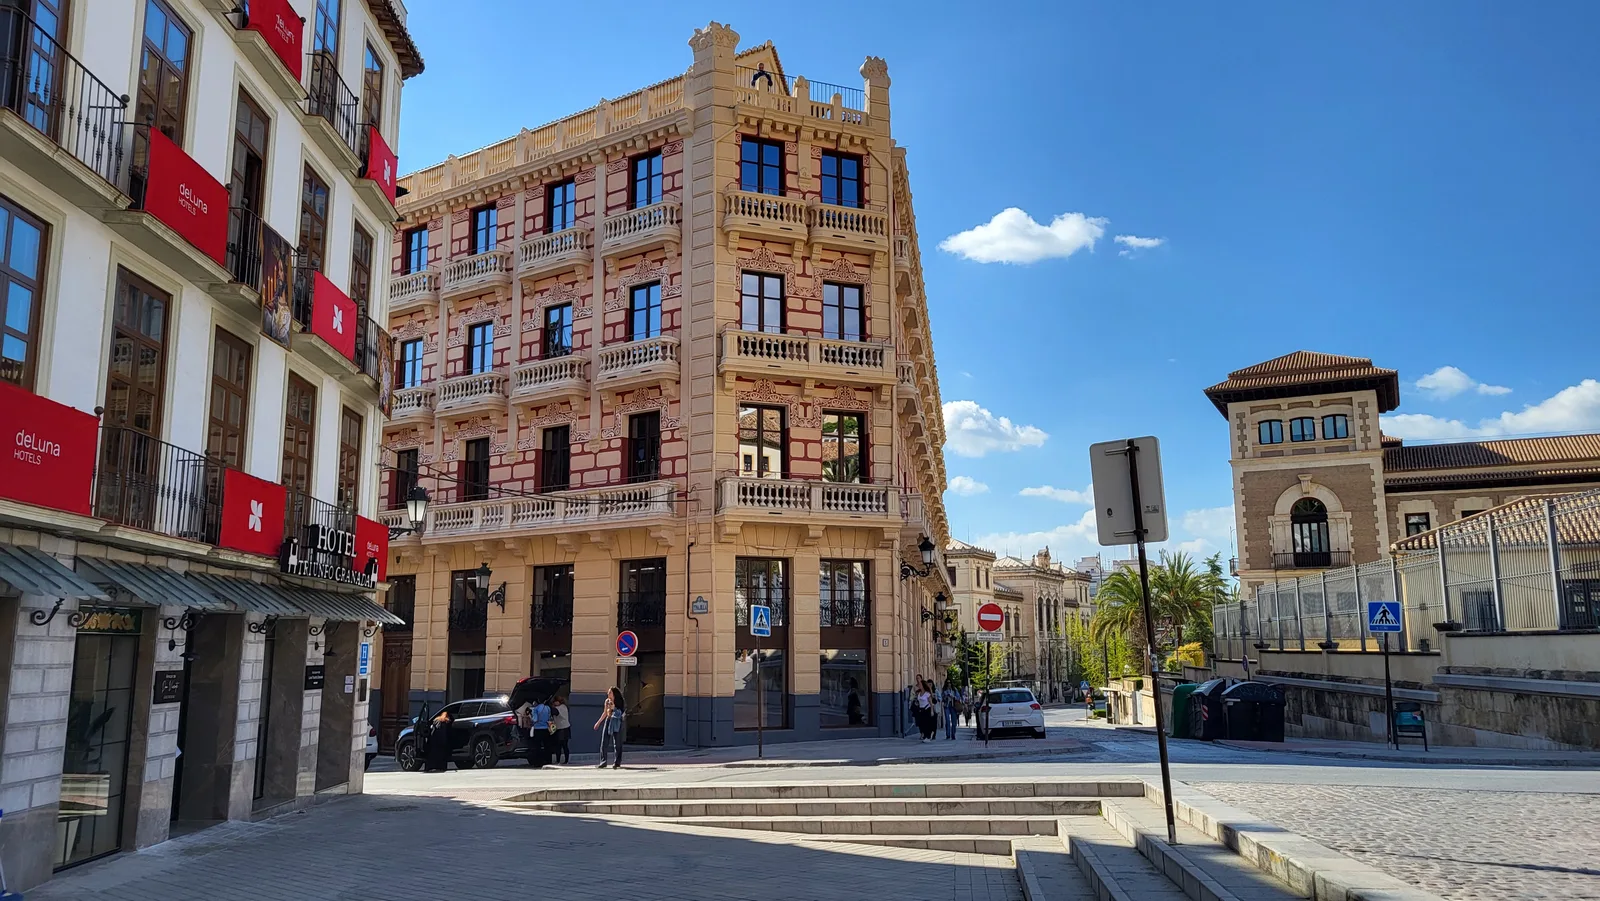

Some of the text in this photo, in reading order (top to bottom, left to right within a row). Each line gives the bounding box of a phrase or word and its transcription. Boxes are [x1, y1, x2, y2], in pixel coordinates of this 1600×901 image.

[178, 196, 197, 216] HOTELS
[179, 183, 208, 215] deLuna
[13, 448, 42, 466] HOTELS
[15, 429, 61, 457] deLuna
[317, 525, 358, 558] HOTEL
[298, 560, 372, 589] TRIUNFO GRANADA
[362, 645, 368, 659] H
